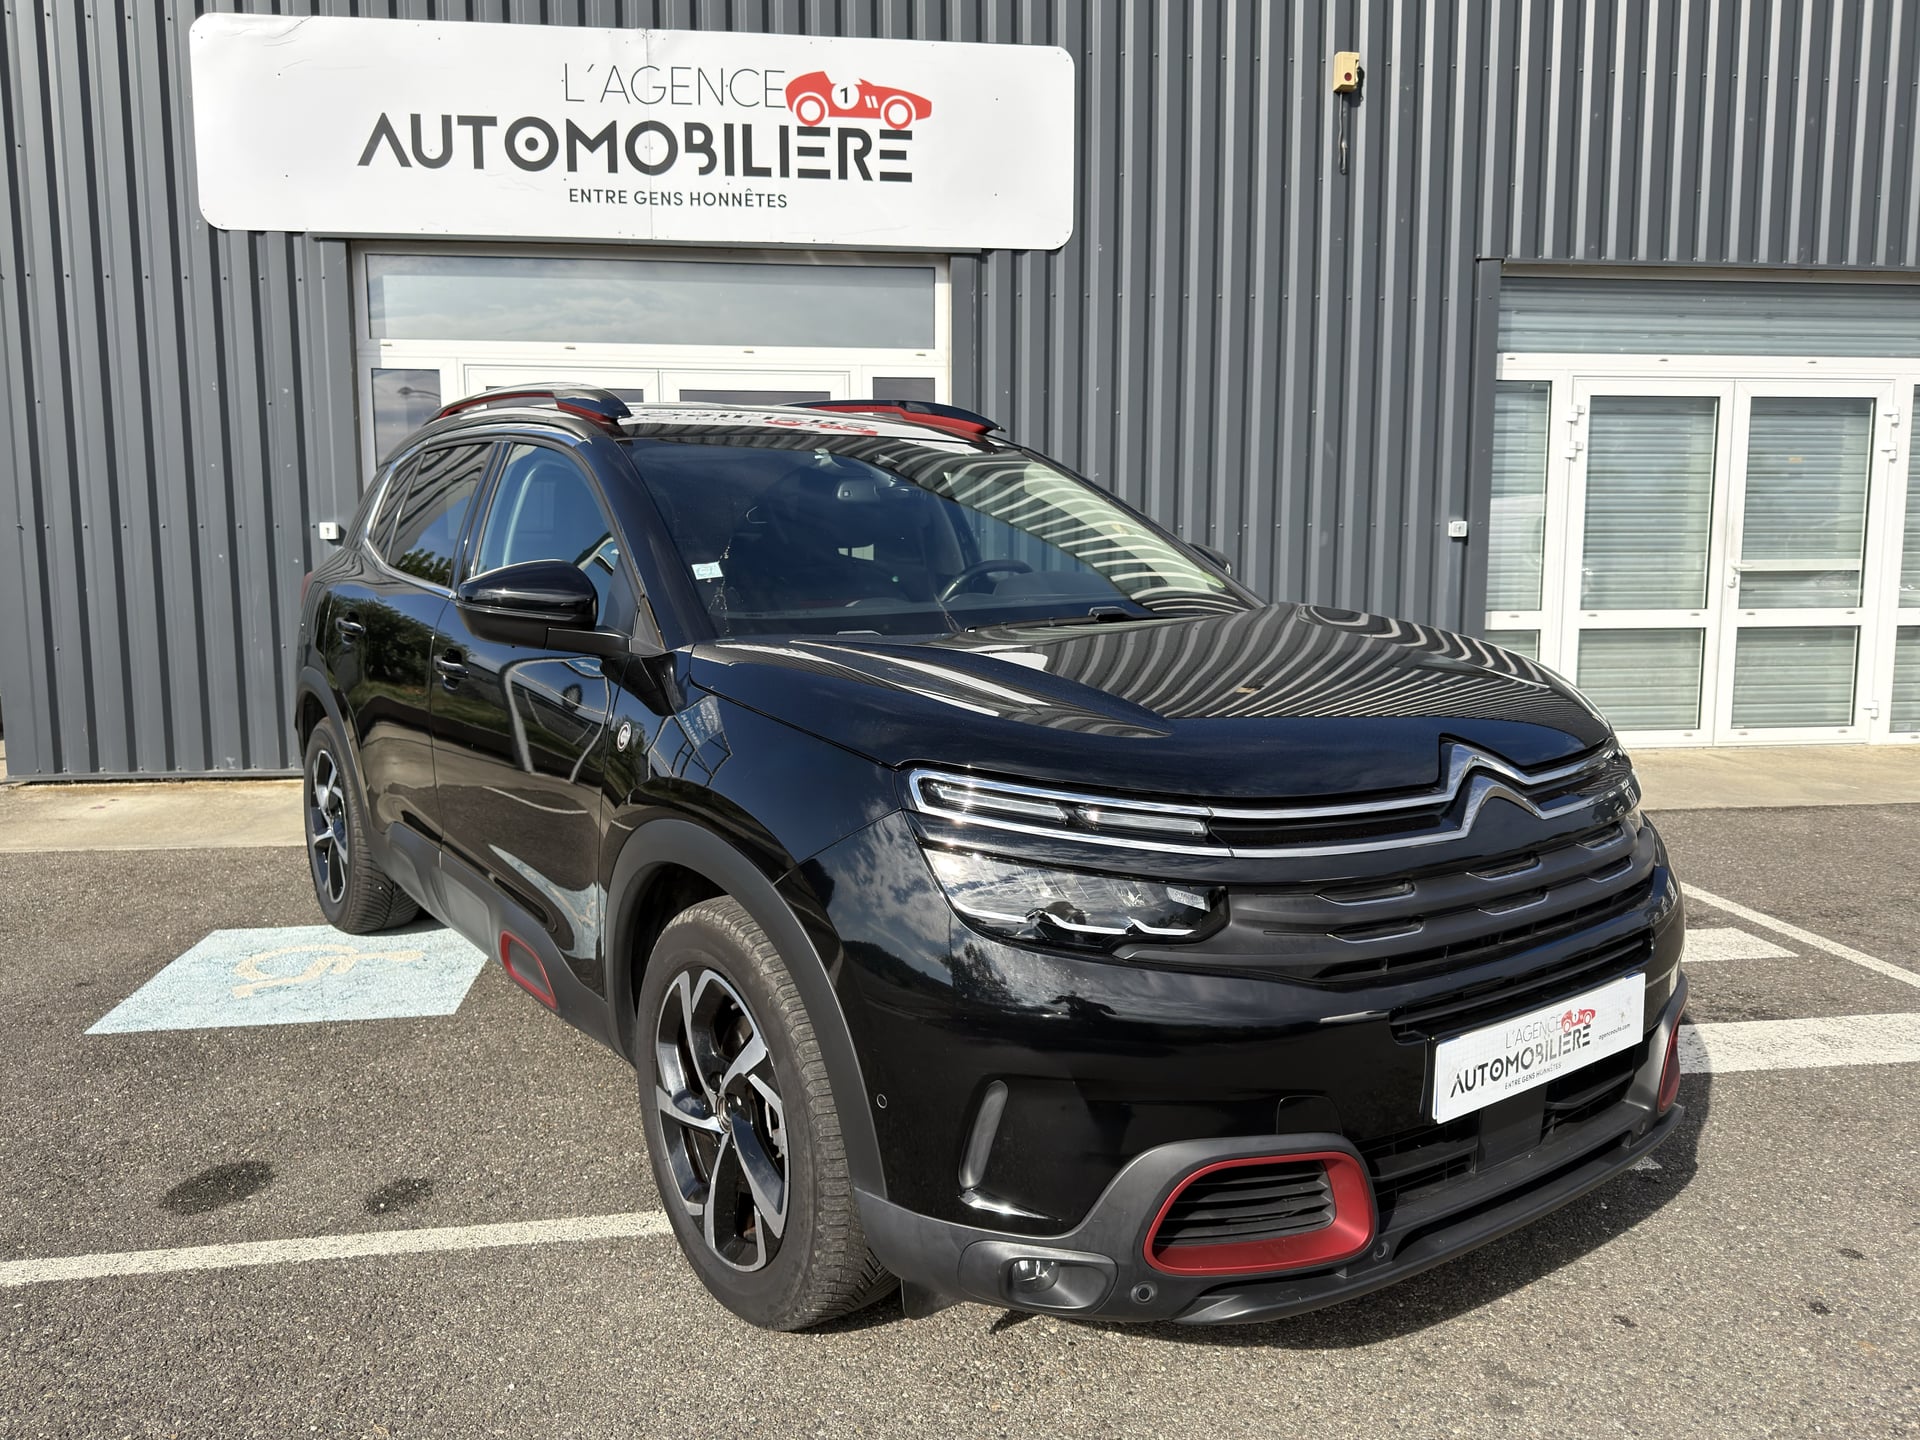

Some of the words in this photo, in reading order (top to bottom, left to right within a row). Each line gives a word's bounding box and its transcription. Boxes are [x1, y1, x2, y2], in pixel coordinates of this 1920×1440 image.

[564, 63, 786, 109] L'AGENCE
[839, 87, 849, 104] 1
[569, 188, 627, 204] ENTRE
[634, 190, 683, 206] GENS
[690, 188, 787, 208] HONNÊTES
[1505, 1013, 1562, 1049] L'AGENCE
[1504, 1077, 1521, 1090] ENTRE
[1521, 1071, 1536, 1083] GENS
